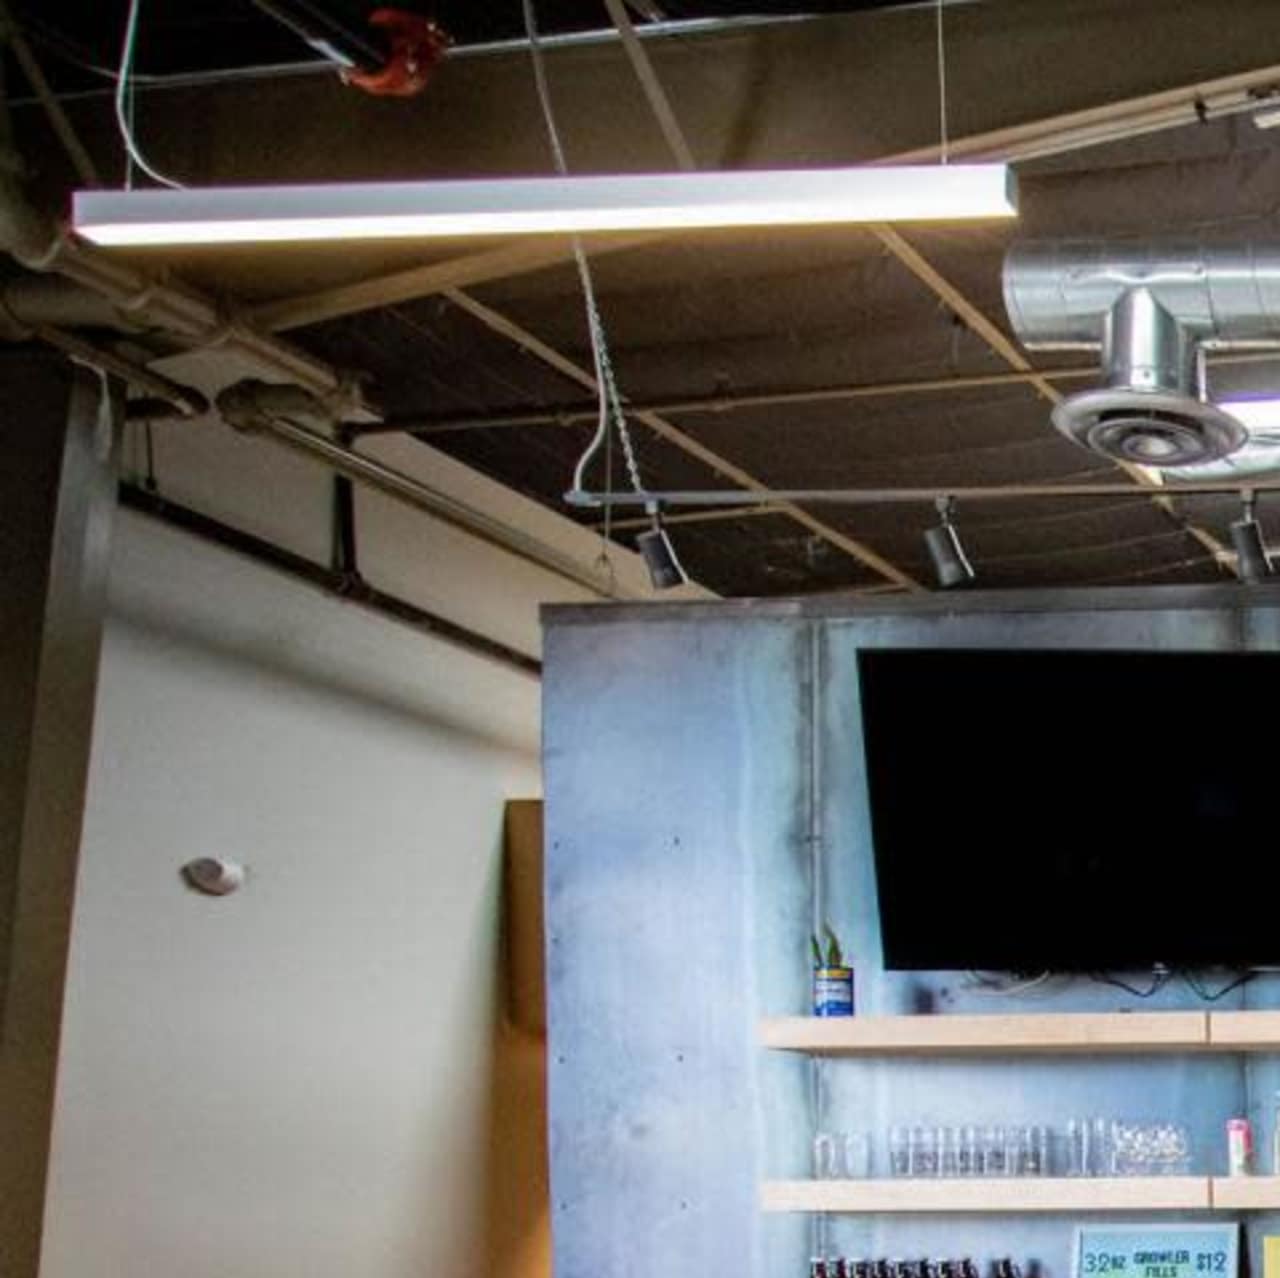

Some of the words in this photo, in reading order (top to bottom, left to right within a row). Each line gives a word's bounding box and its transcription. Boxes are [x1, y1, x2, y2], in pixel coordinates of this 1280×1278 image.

[1133, 1250, 1190, 1264] GROWLER
[1197, 1252, 1227, 1272] $12
[1145, 1266, 1178, 1278] FILLS
